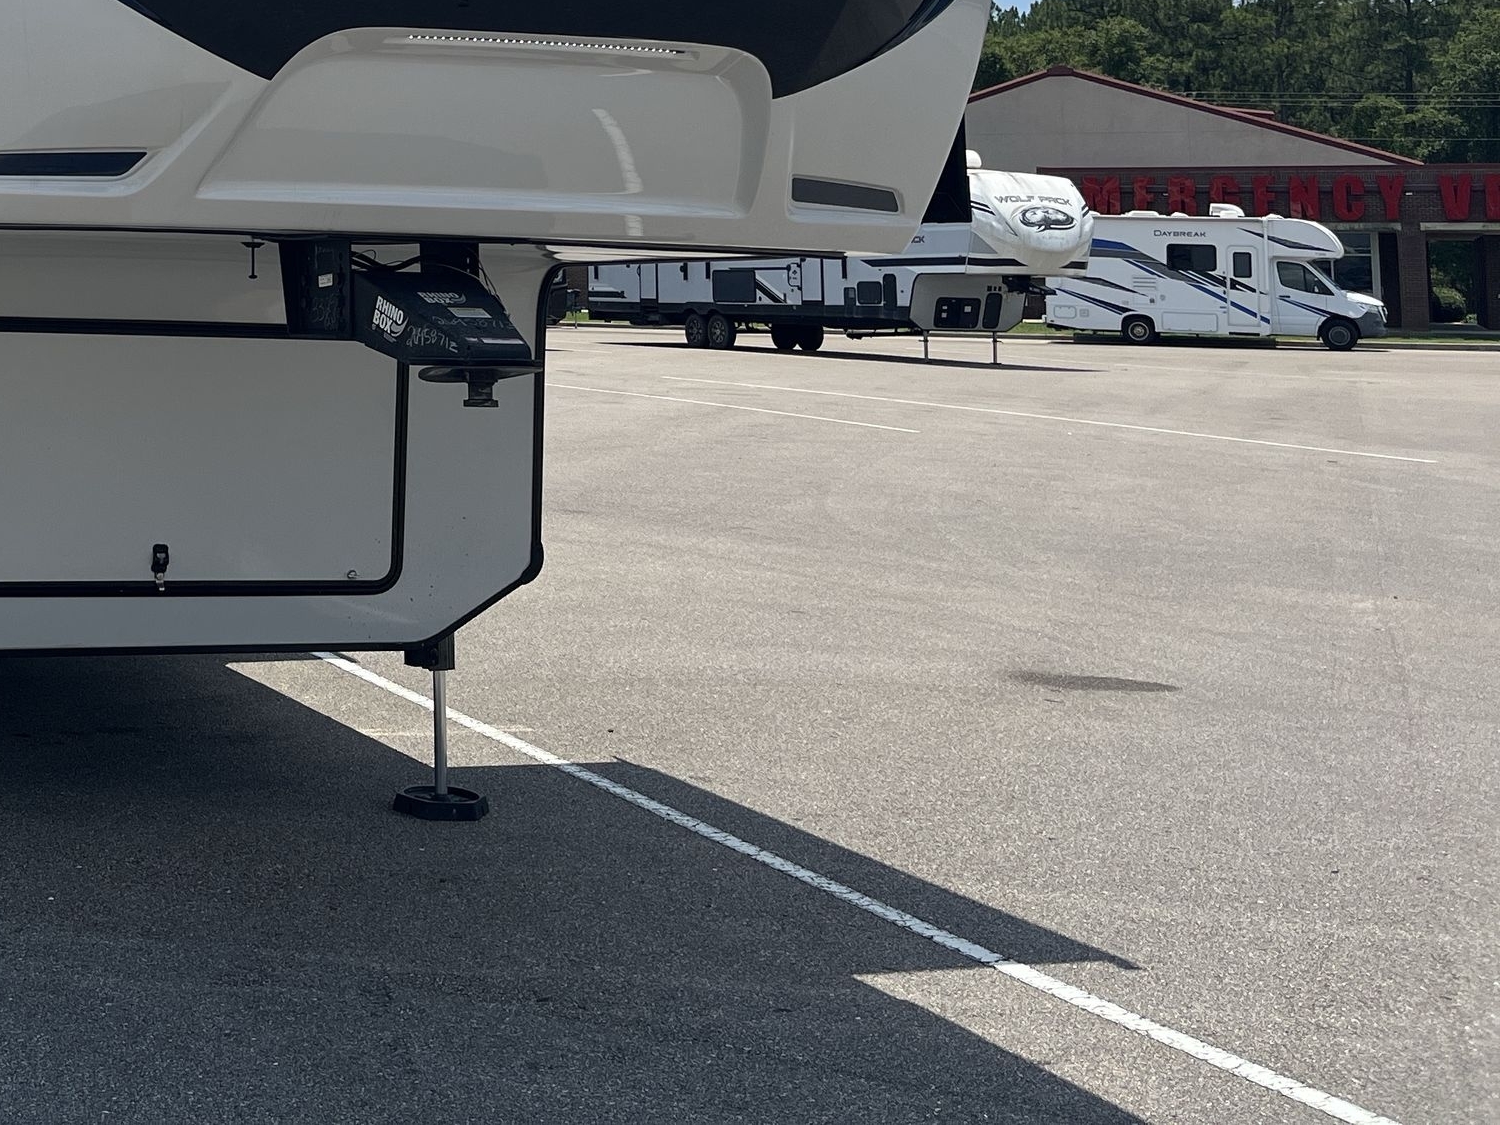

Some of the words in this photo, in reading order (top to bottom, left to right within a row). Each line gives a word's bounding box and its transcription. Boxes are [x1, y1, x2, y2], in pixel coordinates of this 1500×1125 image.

[994, 195, 1035, 204] WOLF
[1081, 174, 1405, 221] MERGENCY
[1153, 229, 1207, 238] DAYBREAK
[372, 309, 392, 334] BOX
[375, 295, 404, 325] RHINO
